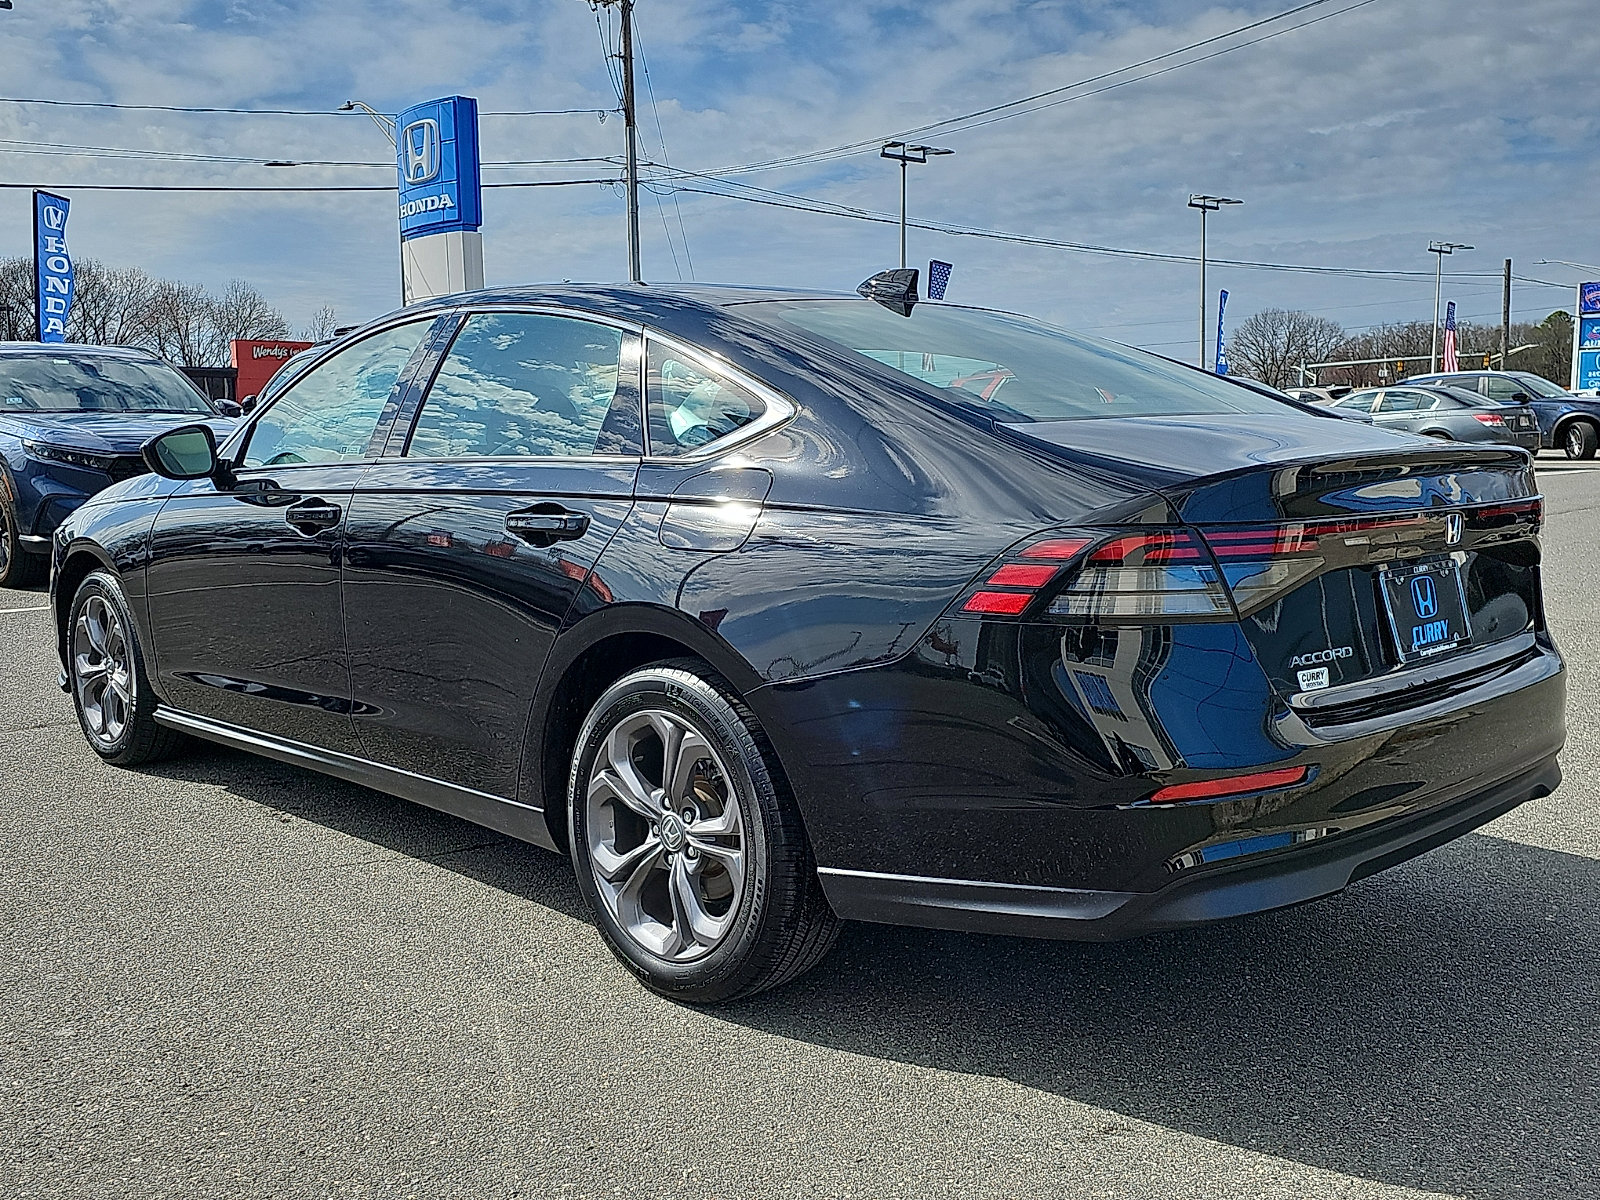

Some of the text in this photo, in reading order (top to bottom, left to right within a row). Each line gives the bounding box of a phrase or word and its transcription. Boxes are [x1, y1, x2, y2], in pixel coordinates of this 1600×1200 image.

[400, 194, 455, 218] HONDA
[44, 236, 70, 335] HONDA
[252, 344, 288, 359] Wendy's
[1412, 618, 1449, 646] CURRY
[1288, 646, 1353, 669] ACCORD
[1301, 669, 1325, 683] CURRY
[679, 689, 728, 738] MICHELIN
